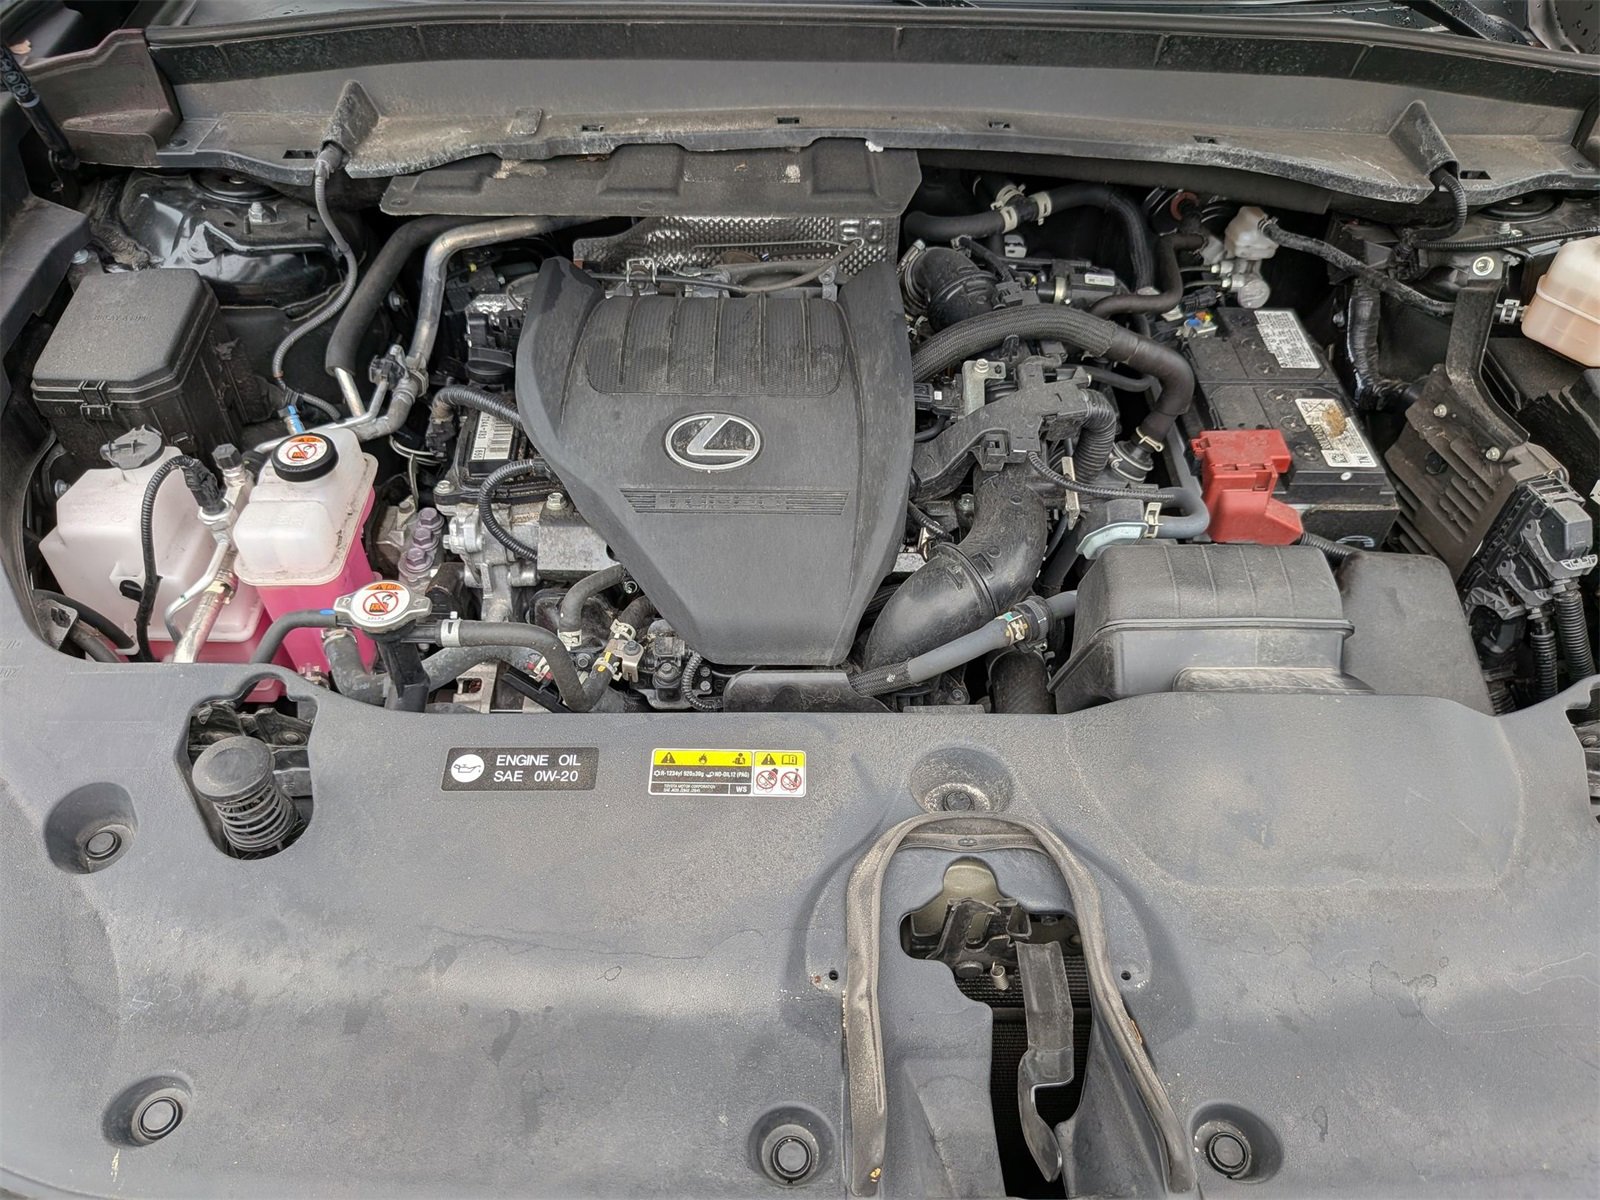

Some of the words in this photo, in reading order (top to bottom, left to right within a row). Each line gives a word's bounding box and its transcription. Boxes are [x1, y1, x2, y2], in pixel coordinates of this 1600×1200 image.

[496, 754, 550, 766] ENGINE
[558, 754, 582, 766] OIL
[493, 770, 524, 782] SAE
[534, 770, 579, 782] 0W-20
